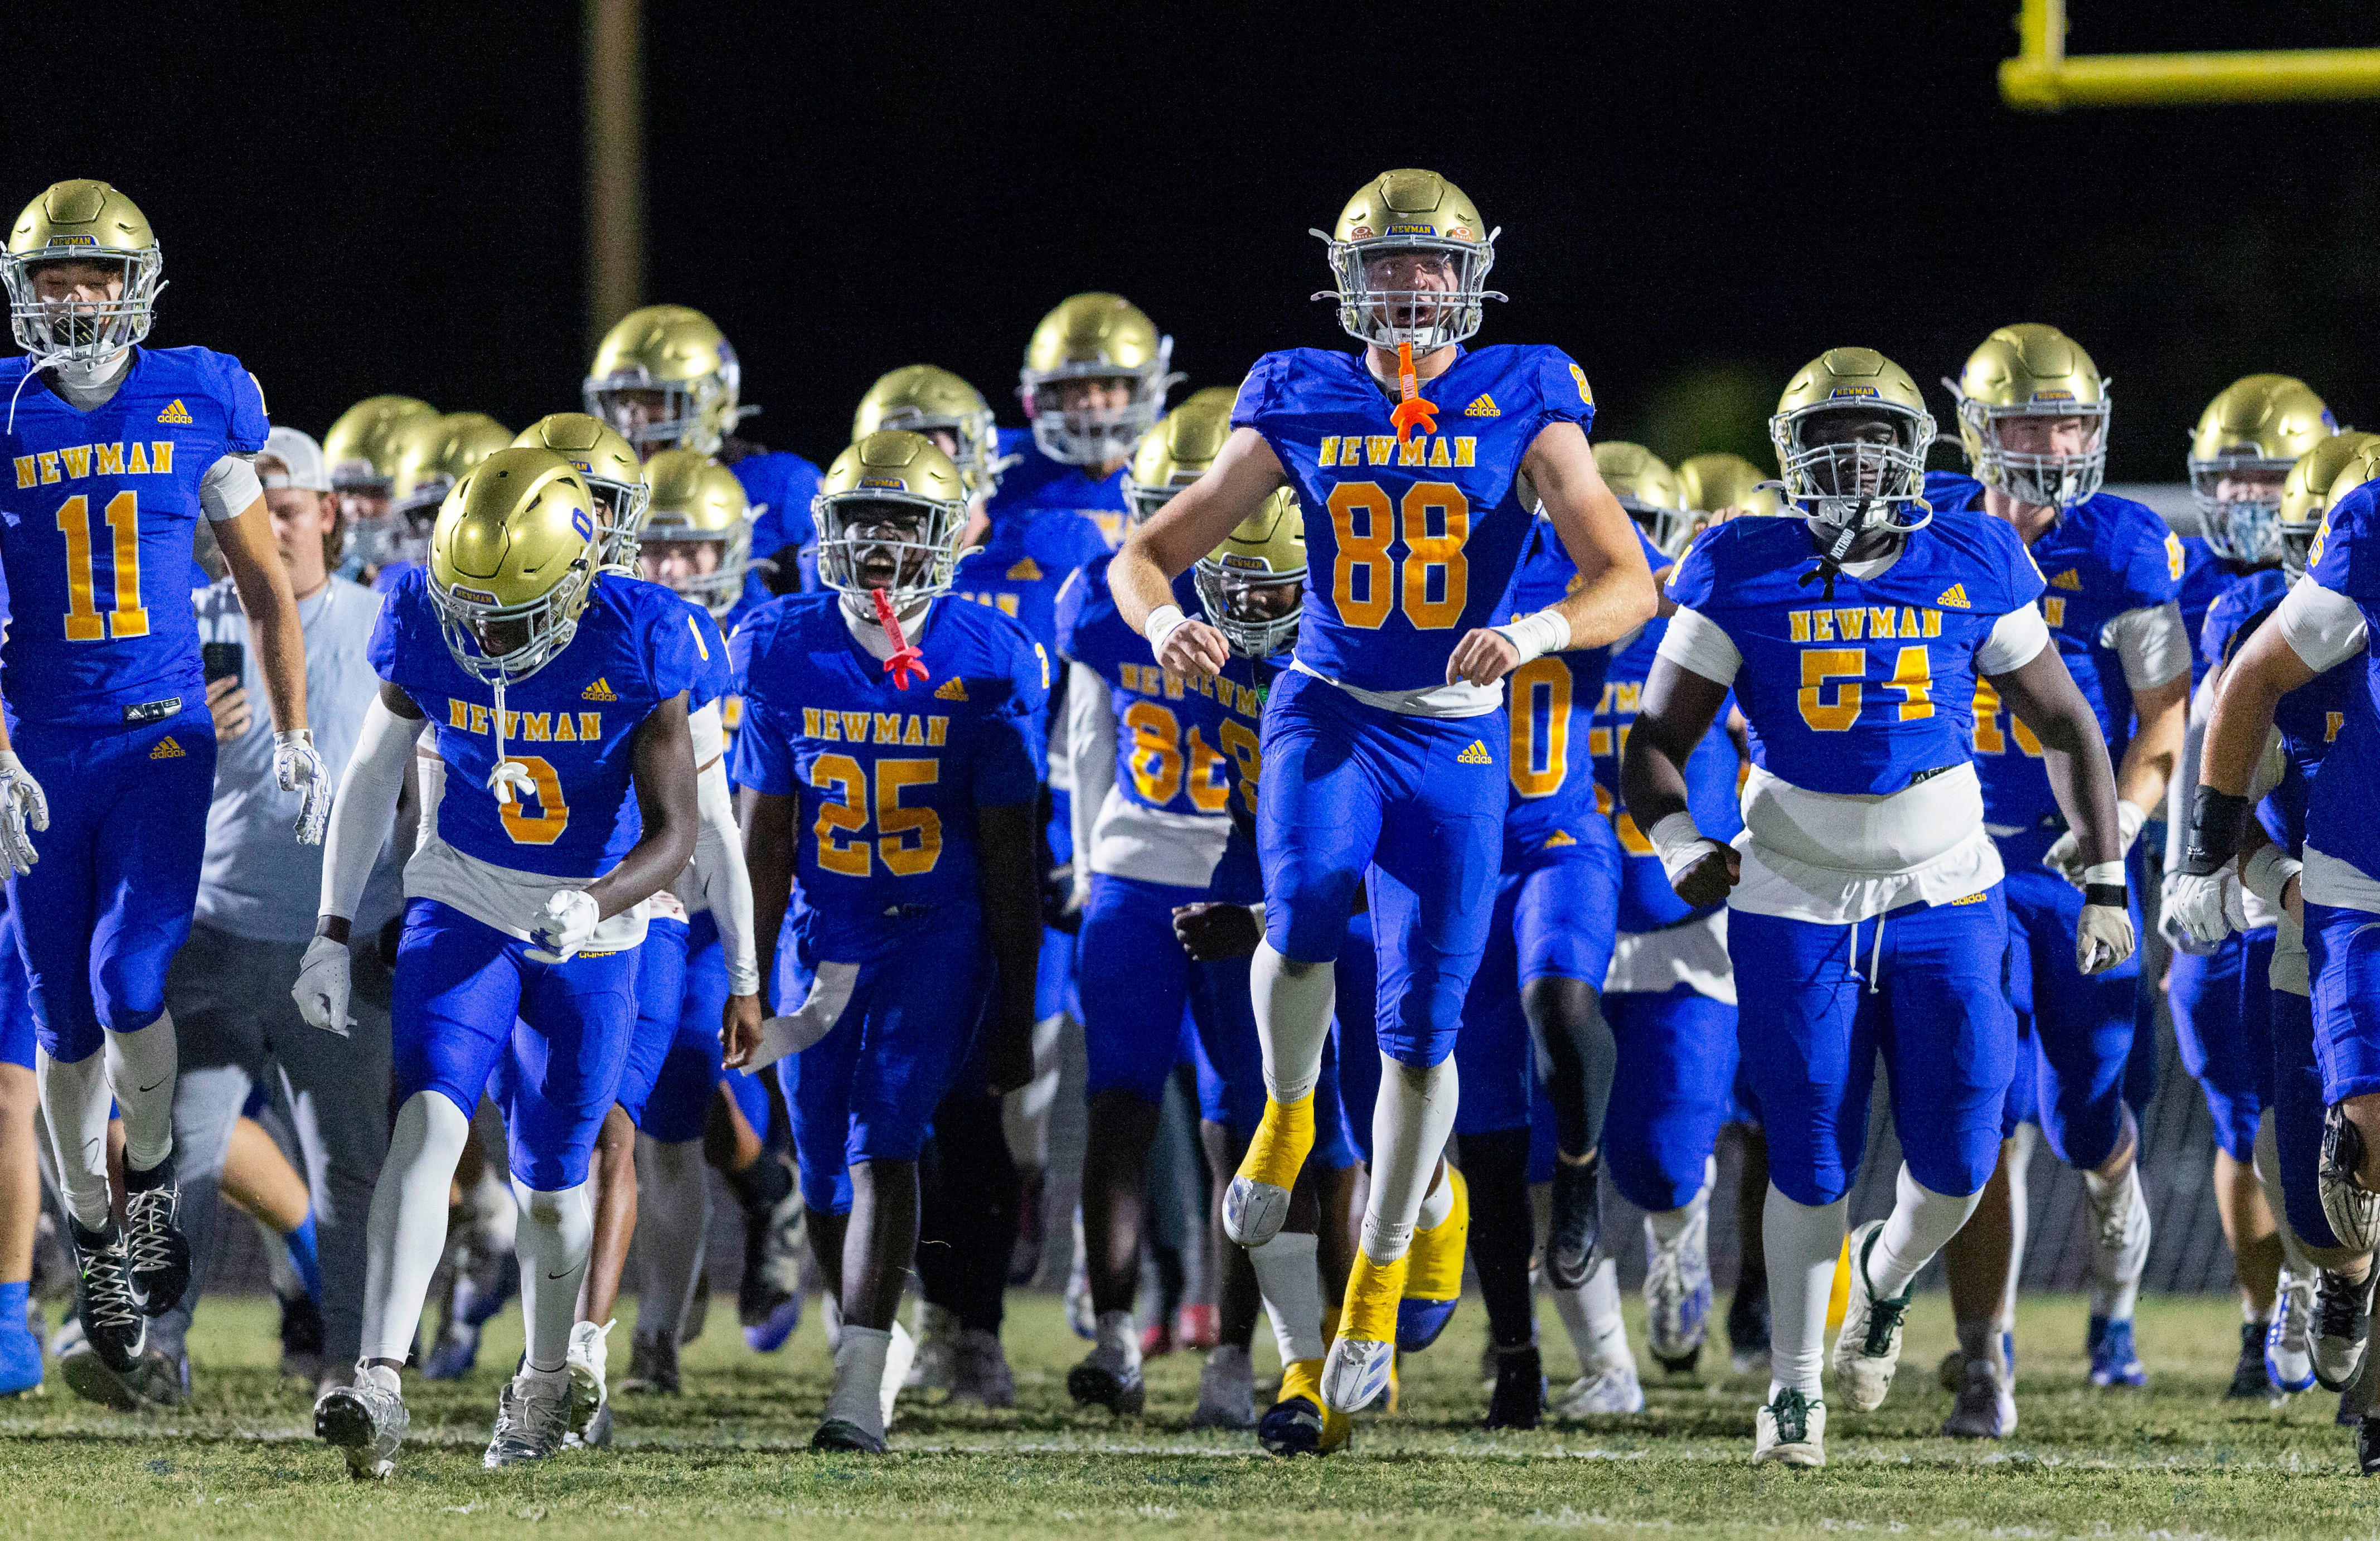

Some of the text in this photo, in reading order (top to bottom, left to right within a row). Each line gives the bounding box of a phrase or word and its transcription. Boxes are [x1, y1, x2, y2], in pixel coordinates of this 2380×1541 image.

[1392, 225, 1431, 234] NEWMAN
[157, 413, 193, 424] adidas
[1465, 406, 1501, 418] adidas
[13, 441, 174, 489] NEWMAN
[1319, 436, 1477, 467] NEWMAN
[1326, 481, 1470, 630] 88
[1830, 528, 1855, 560] NXTRND
[56, 490, 150, 641] 11
[1937, 596, 1971, 609] adidas
[1788, 606, 1943, 643] NEWMAN
[581, 689, 617, 702] adidas
[448, 697, 602, 742] NEWMAN
[802, 707, 949, 747] NEWMAN
[149, 748, 186, 759] adidas
[1457, 752, 1492, 764] adidas
[493, 755, 570, 845] 0
[811, 753, 943, 878] 25
